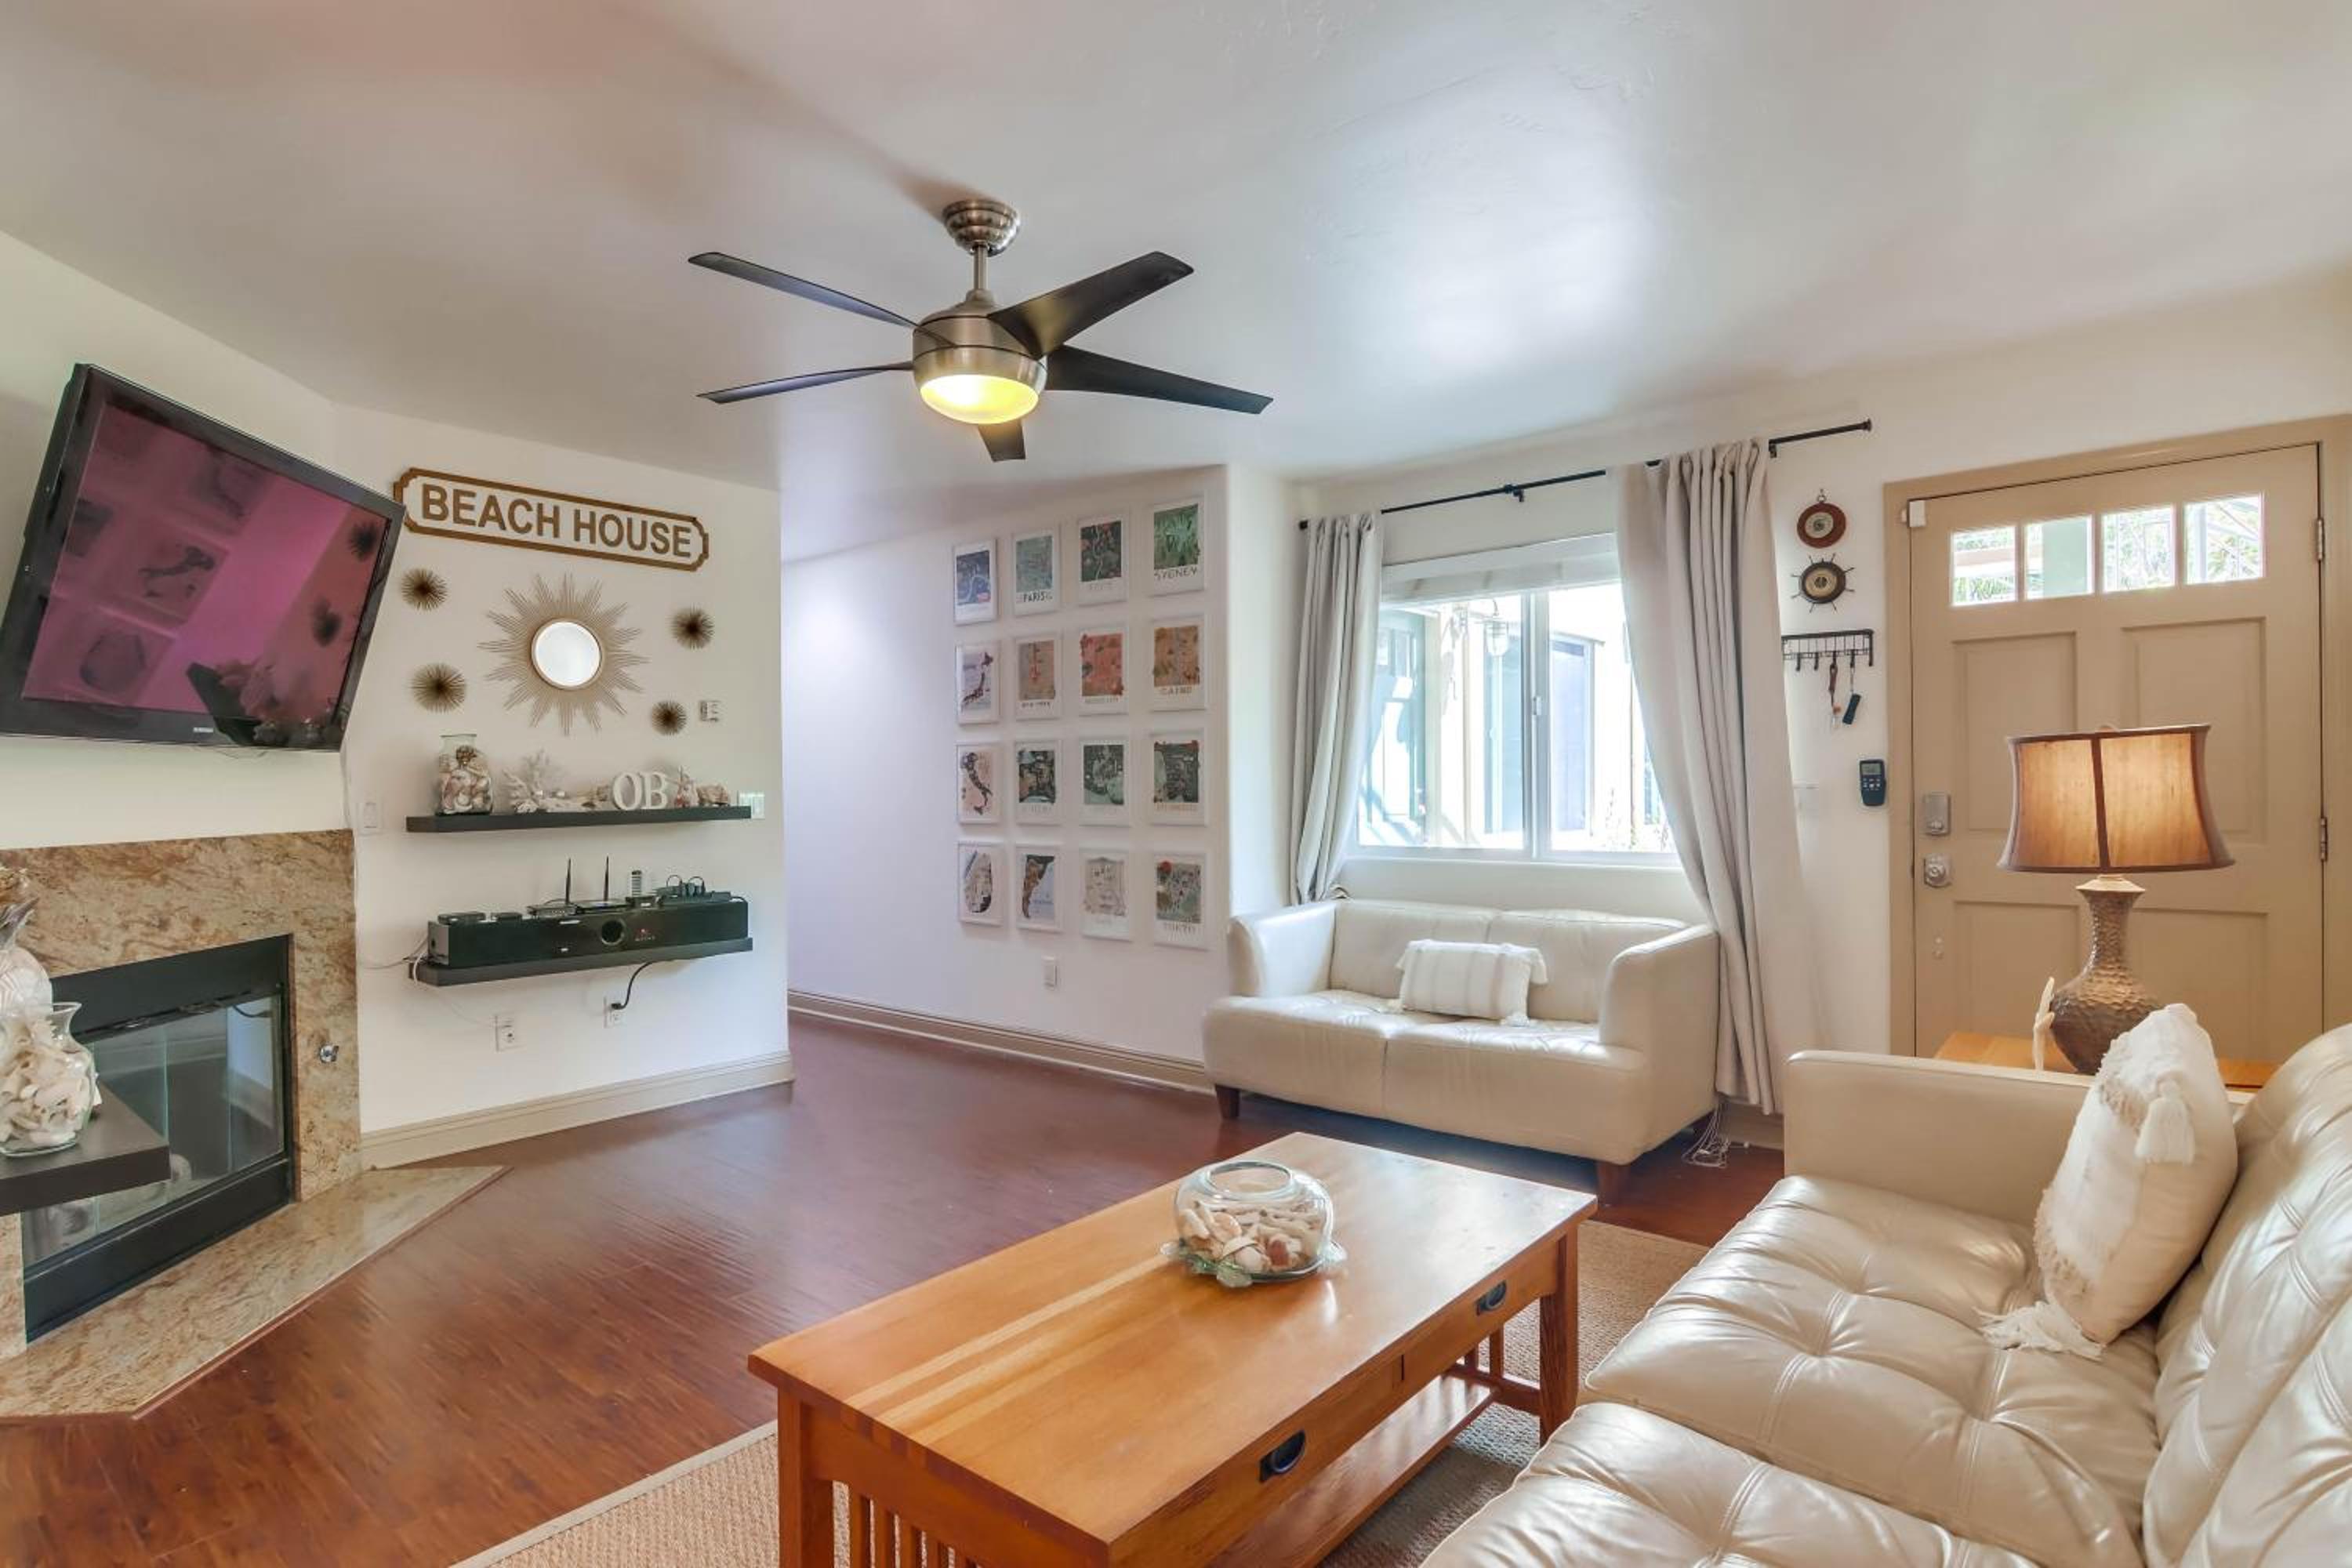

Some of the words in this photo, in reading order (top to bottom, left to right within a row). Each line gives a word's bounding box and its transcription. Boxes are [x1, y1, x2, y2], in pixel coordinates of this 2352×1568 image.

[421, 483, 560, 539] BEACH
[573, 508, 691, 557] HOUSE
[612, 771, 668, 811] OB
